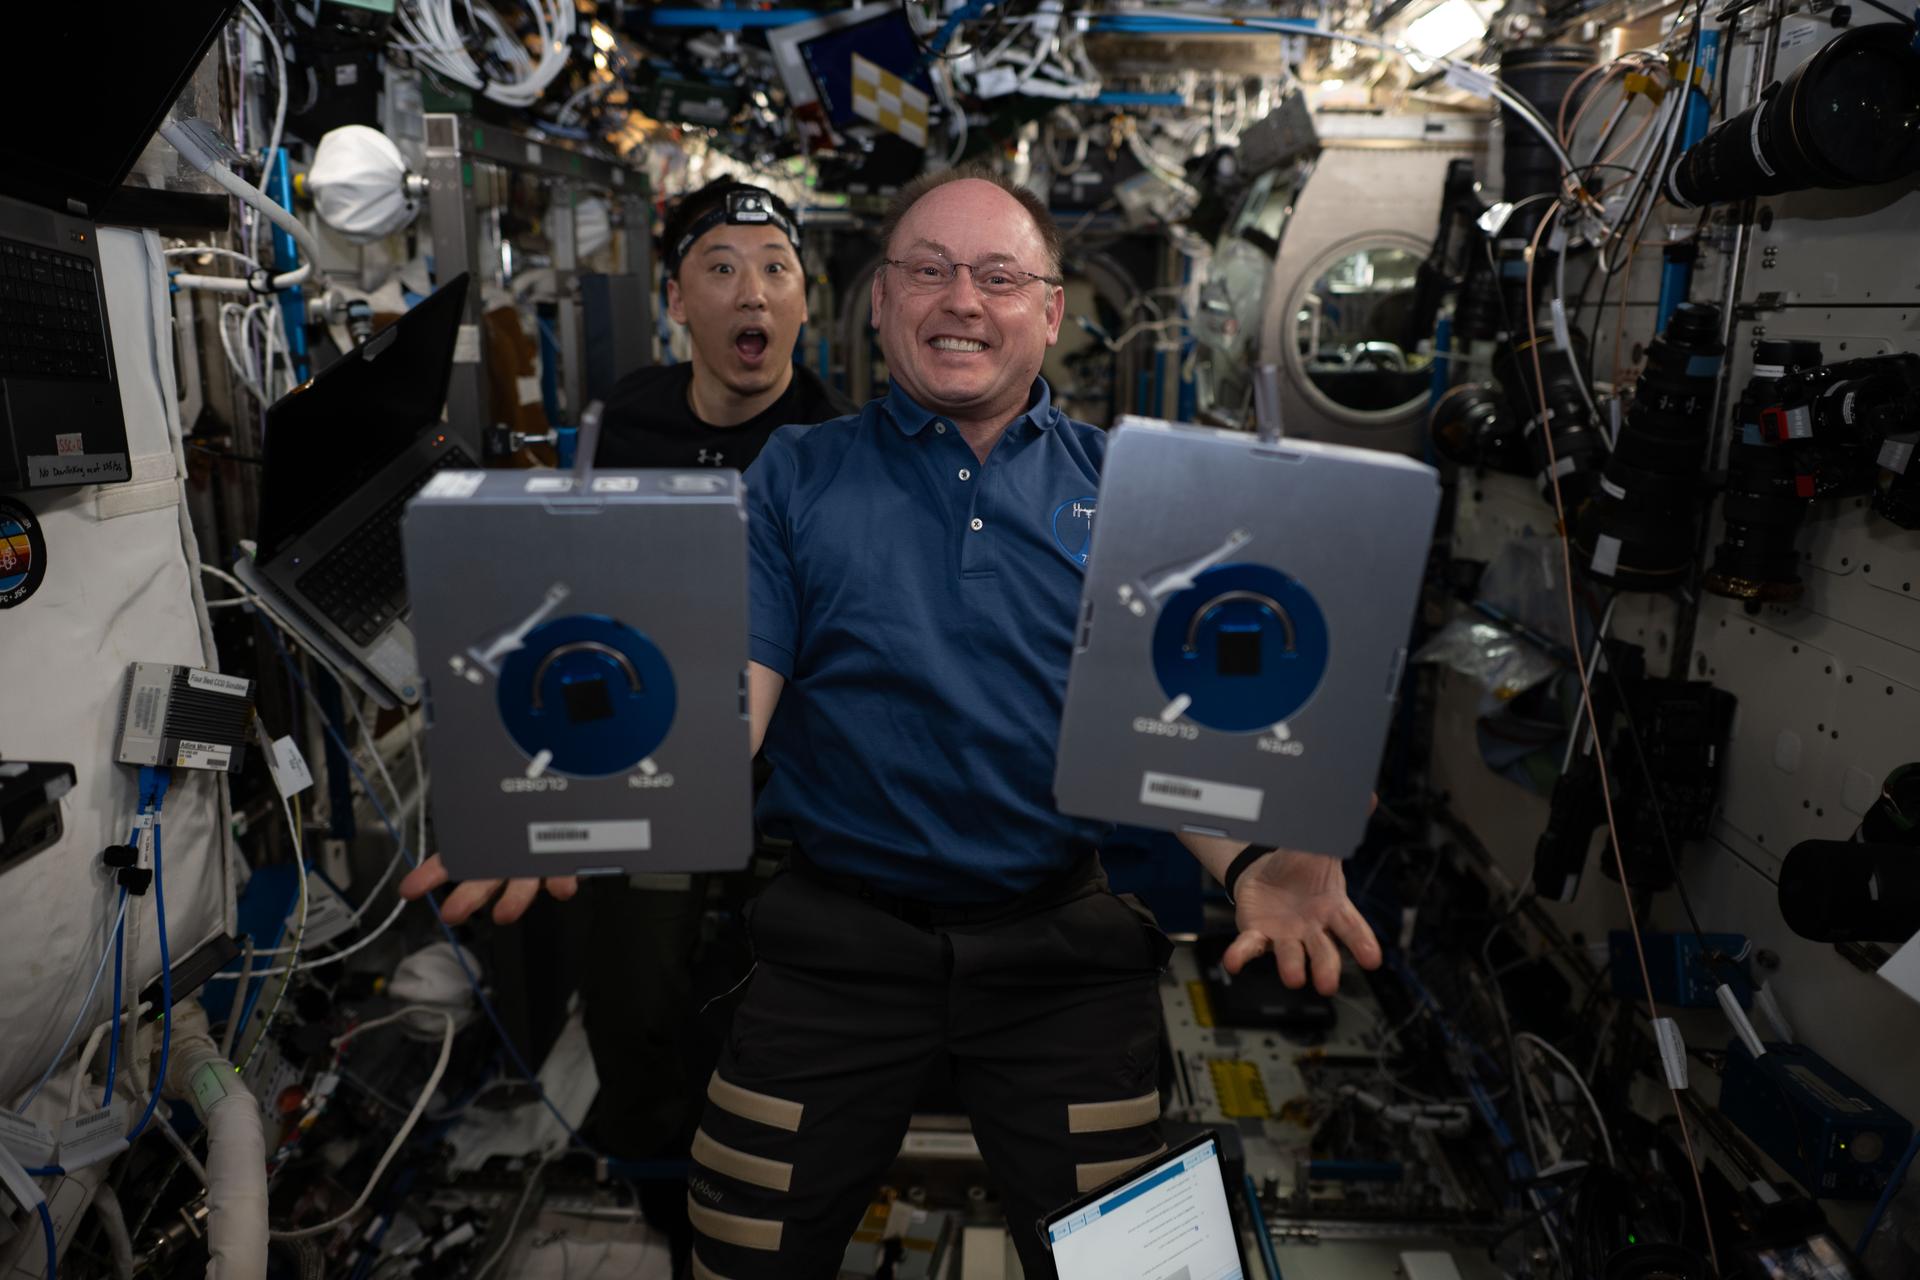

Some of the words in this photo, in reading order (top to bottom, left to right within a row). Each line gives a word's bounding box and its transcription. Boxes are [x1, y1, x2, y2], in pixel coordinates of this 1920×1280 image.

[1133, 716, 1199, 740] CLOSED
[1257, 736, 1304, 757] OPEN
[501, 776, 568, 793] CLOSED
[628, 772, 674, 788] OPEN
